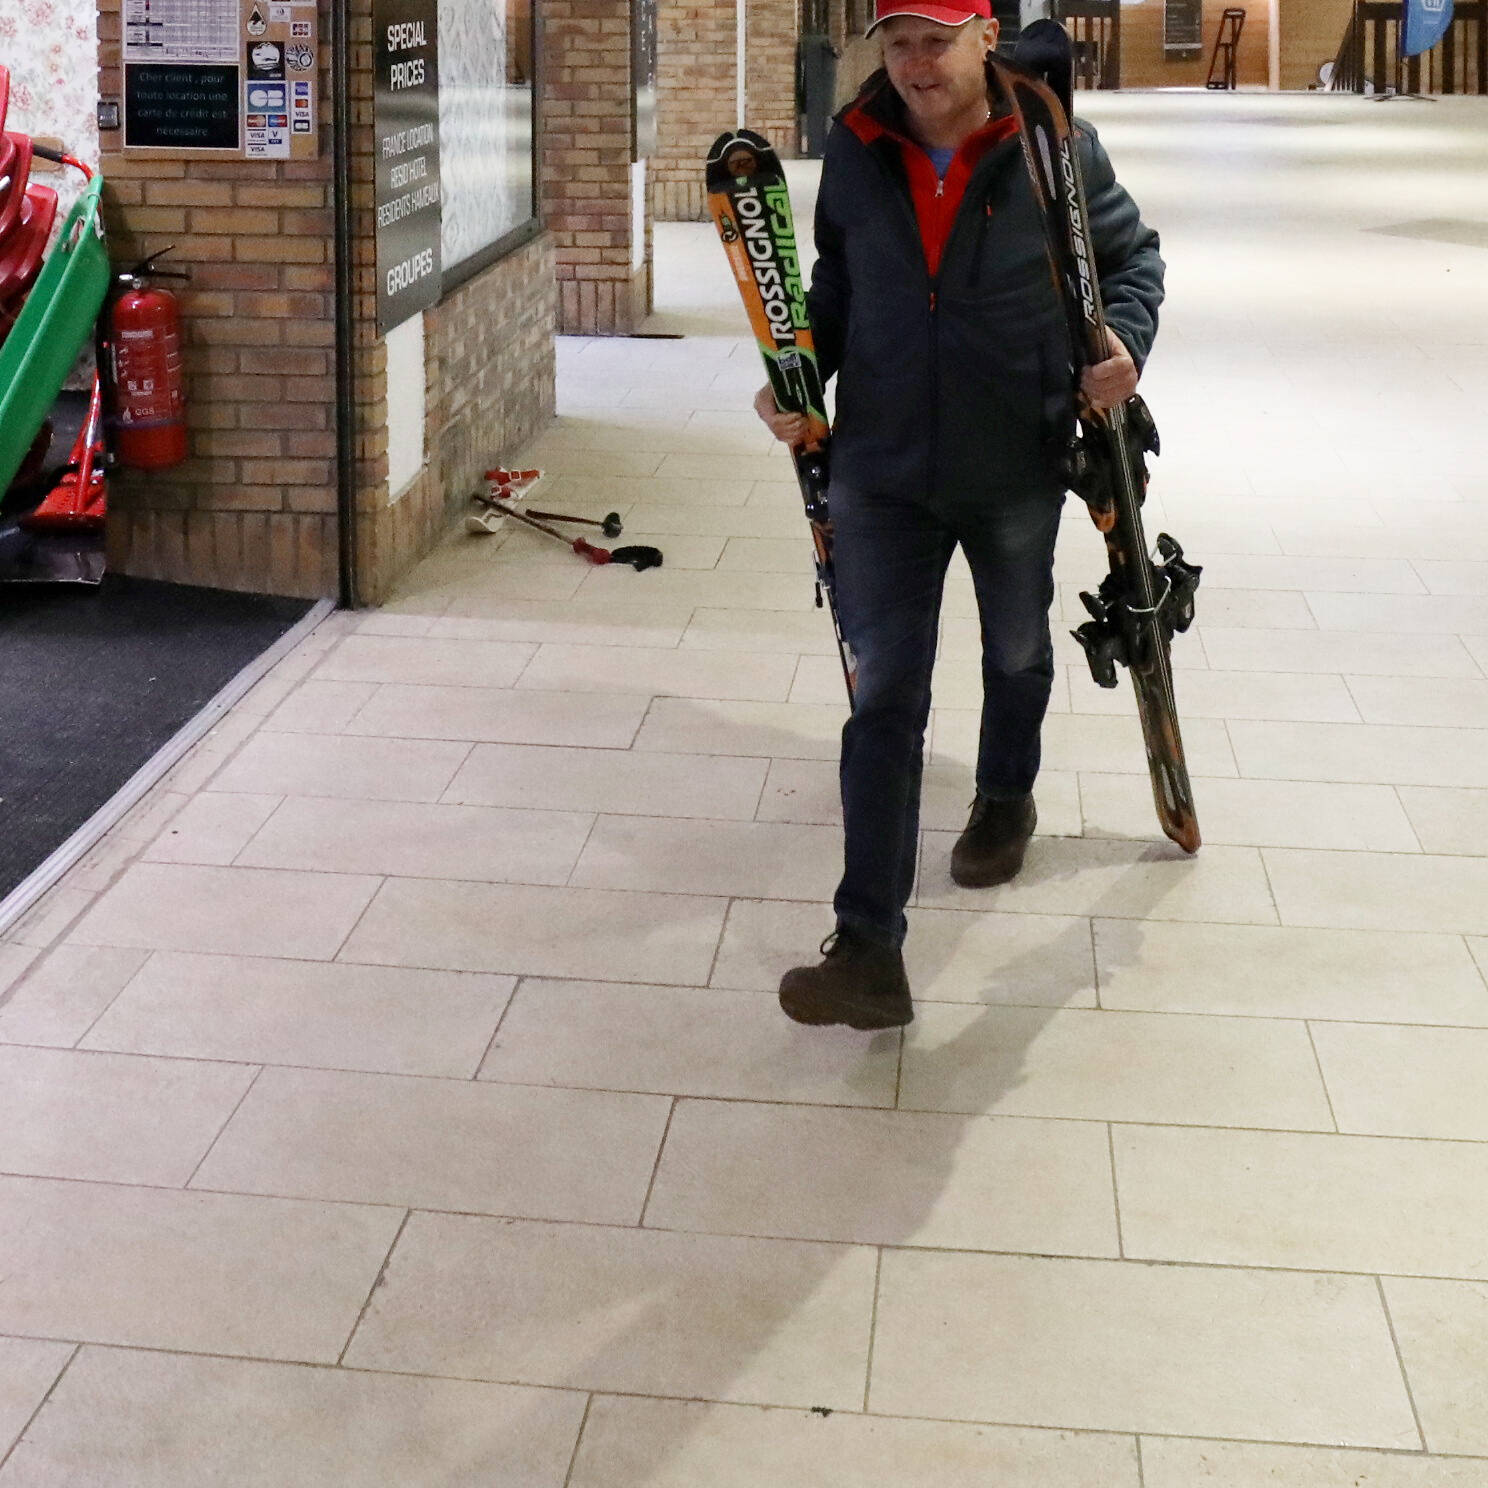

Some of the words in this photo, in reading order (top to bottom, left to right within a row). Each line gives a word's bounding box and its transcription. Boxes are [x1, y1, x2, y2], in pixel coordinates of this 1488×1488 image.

[387, 20, 427, 52] SPECIAL
[390, 59, 425, 91] PRICES
[382, 132, 406, 159] FRANCE
[407, 123, 433, 150] LOCATION
[377, 193, 411, 228] RESIDENTS
[1061, 139, 1096, 326] ROSSIGNOL
[387, 248, 433, 296] GROUPES
[735, 187, 795, 340] ROSSIGNOL
